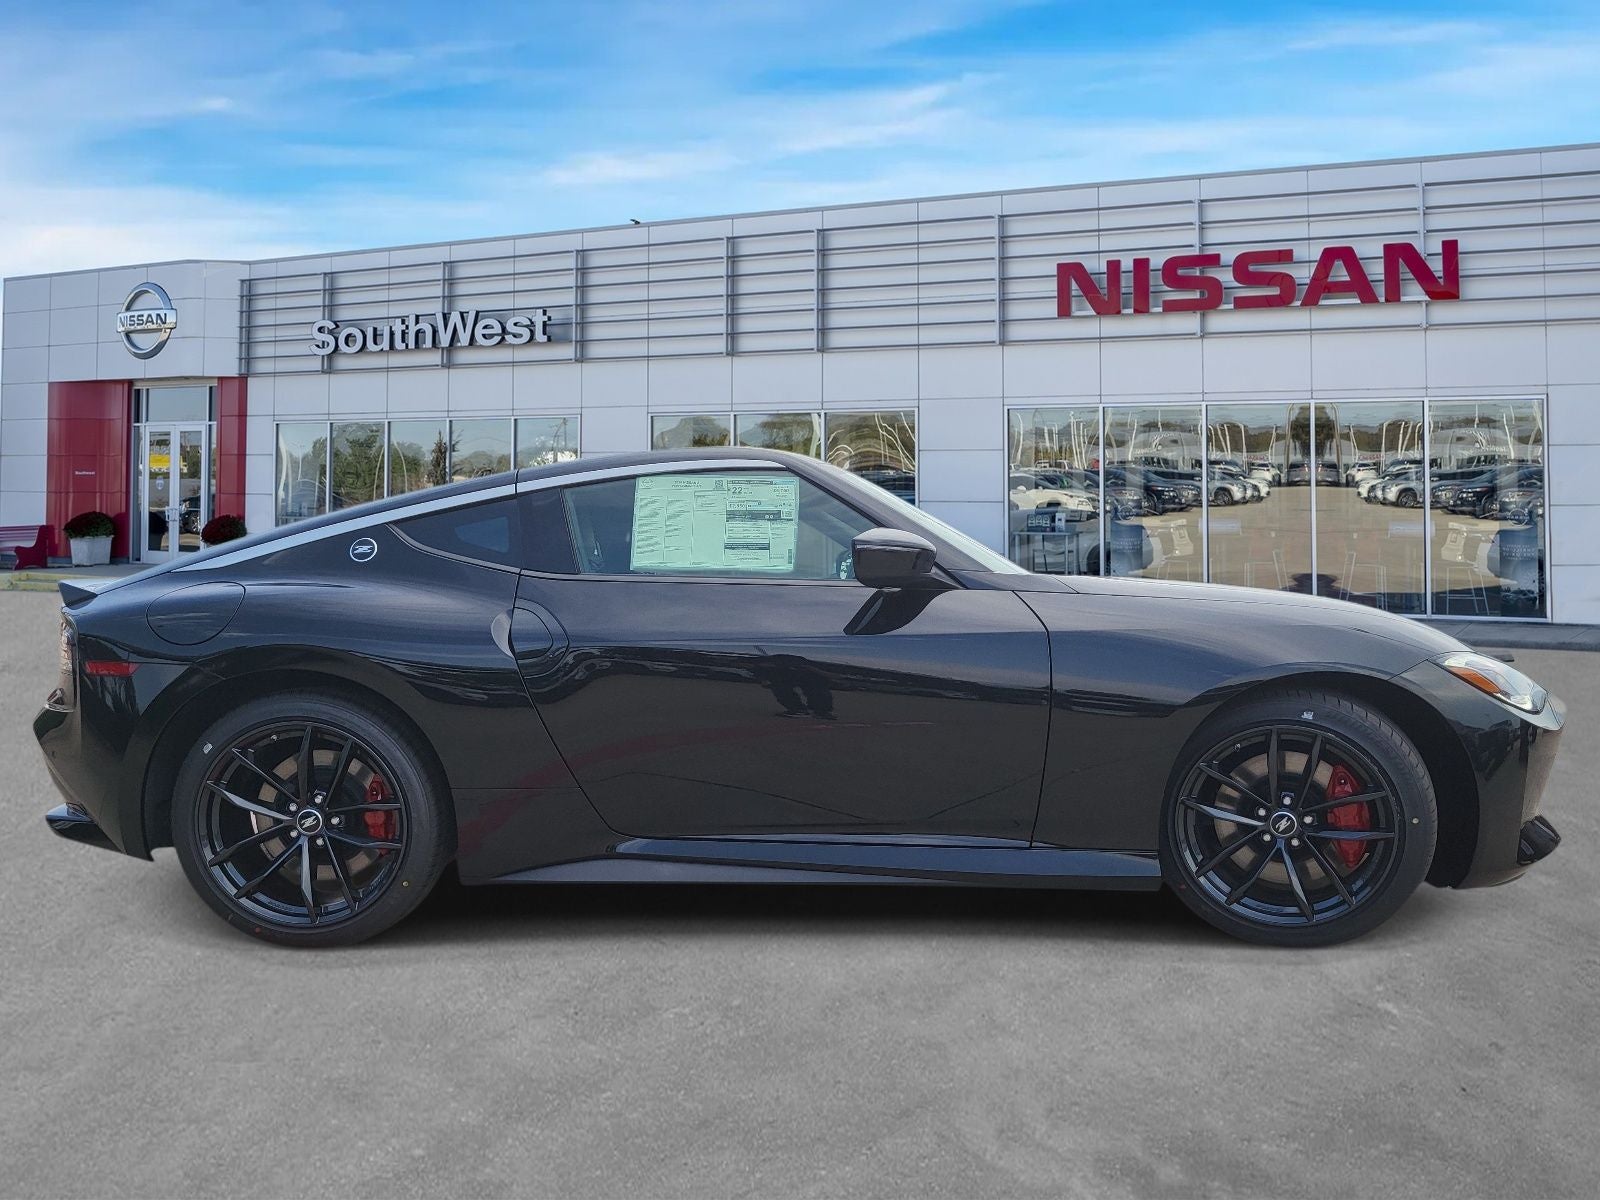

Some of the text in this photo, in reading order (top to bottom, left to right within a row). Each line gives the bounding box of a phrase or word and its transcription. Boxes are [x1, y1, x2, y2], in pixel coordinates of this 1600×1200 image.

[1056, 239, 1461, 318] NISSAN
[119, 312, 167, 328] NISSAN
[309, 307, 551, 356] SouthWest
[731, 486, 743, 494] 22
